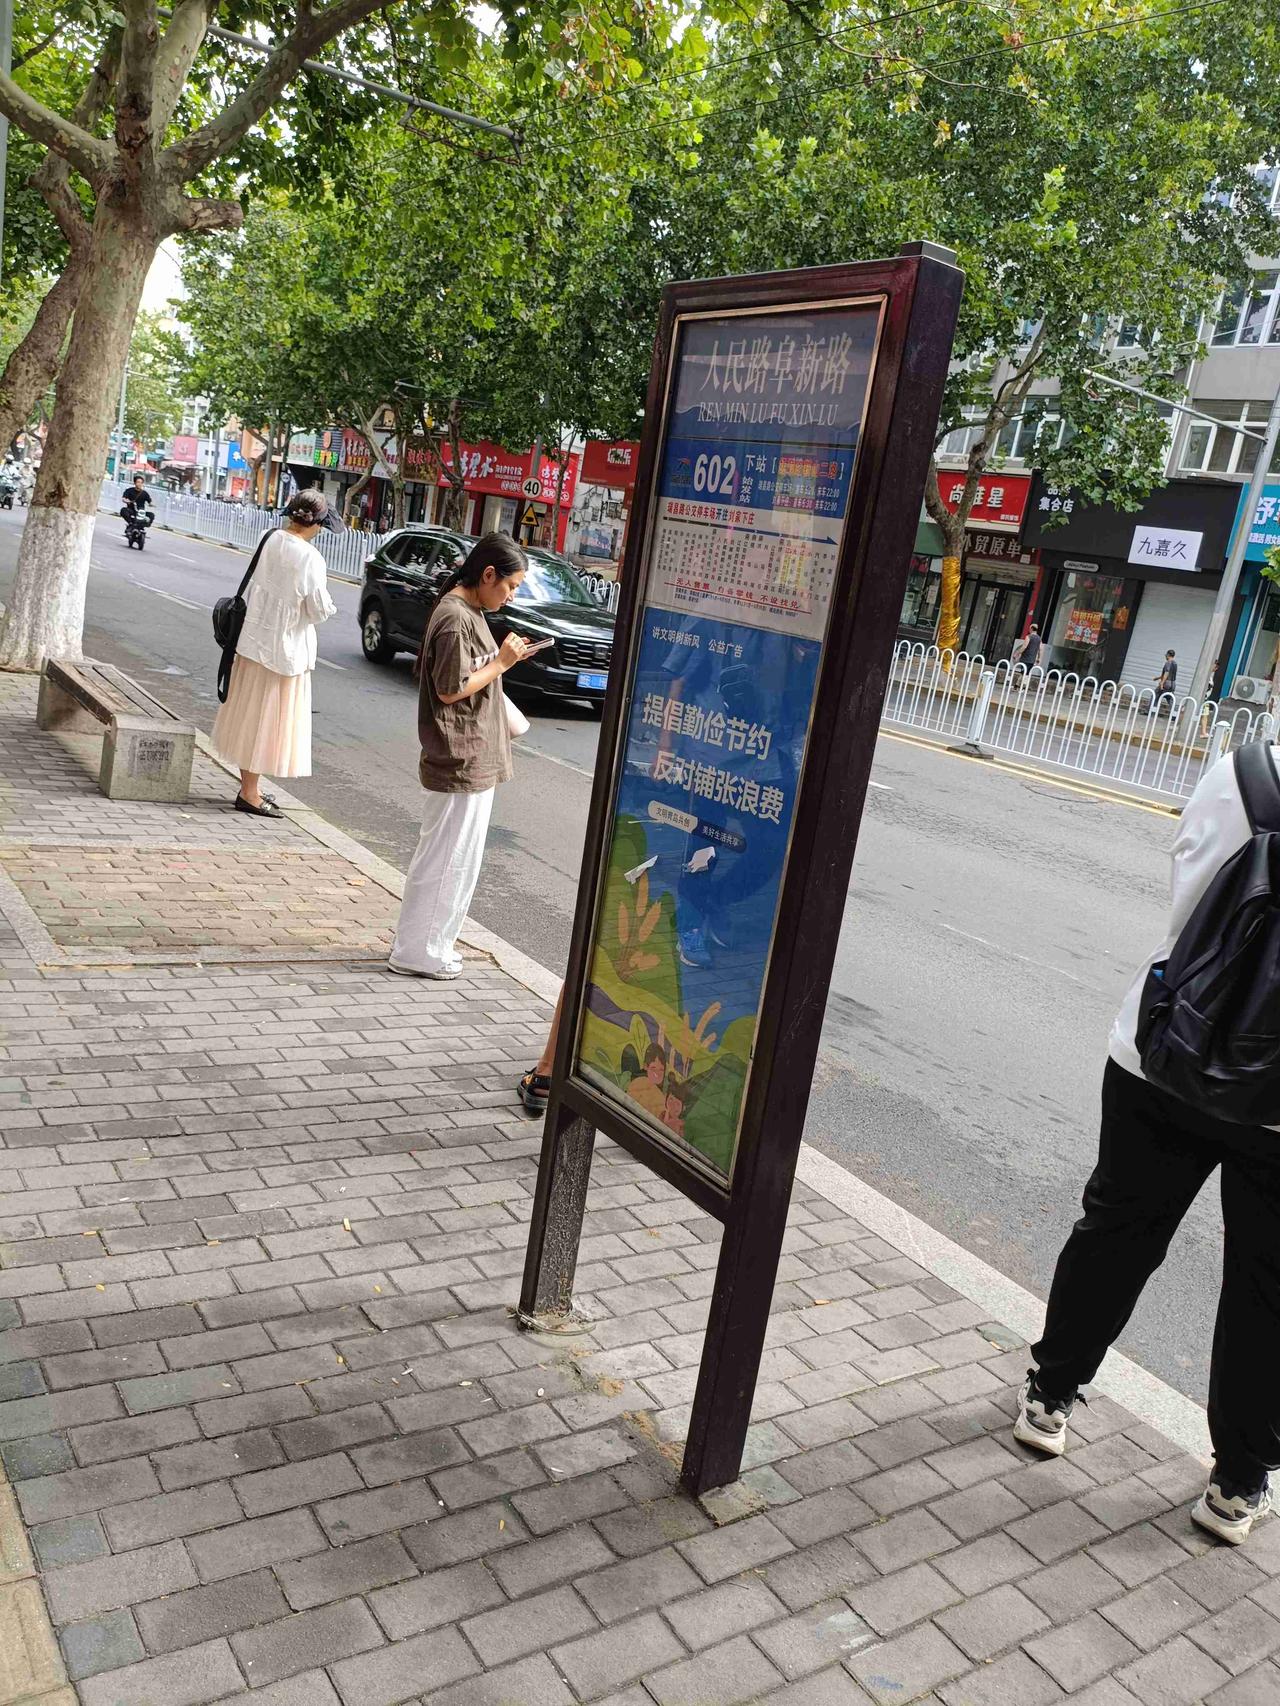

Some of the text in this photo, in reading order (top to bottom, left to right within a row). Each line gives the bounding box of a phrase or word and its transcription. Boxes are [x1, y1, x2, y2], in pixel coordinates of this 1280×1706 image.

[700, 332, 852, 394] 人民路阜新路
[697, 402, 838, 426] REN MIN LU FU XIN LU
[693, 453, 736, 494] 602
[524, 482, 540, 495] 40
[1039, 496, 1074, 513] 集合店
[1253, 496, 1280, 525] 舒
[961, 533, 1021, 558] 外贸原单
[1137, 537, 1187, 560] 九嘉久
[652, 626, 743, 658] 讲文明树新风 公益广告
[642, 693, 773, 761] 提倡勤俭节约
[653, 750, 784, 824] 反对铺张浪费
